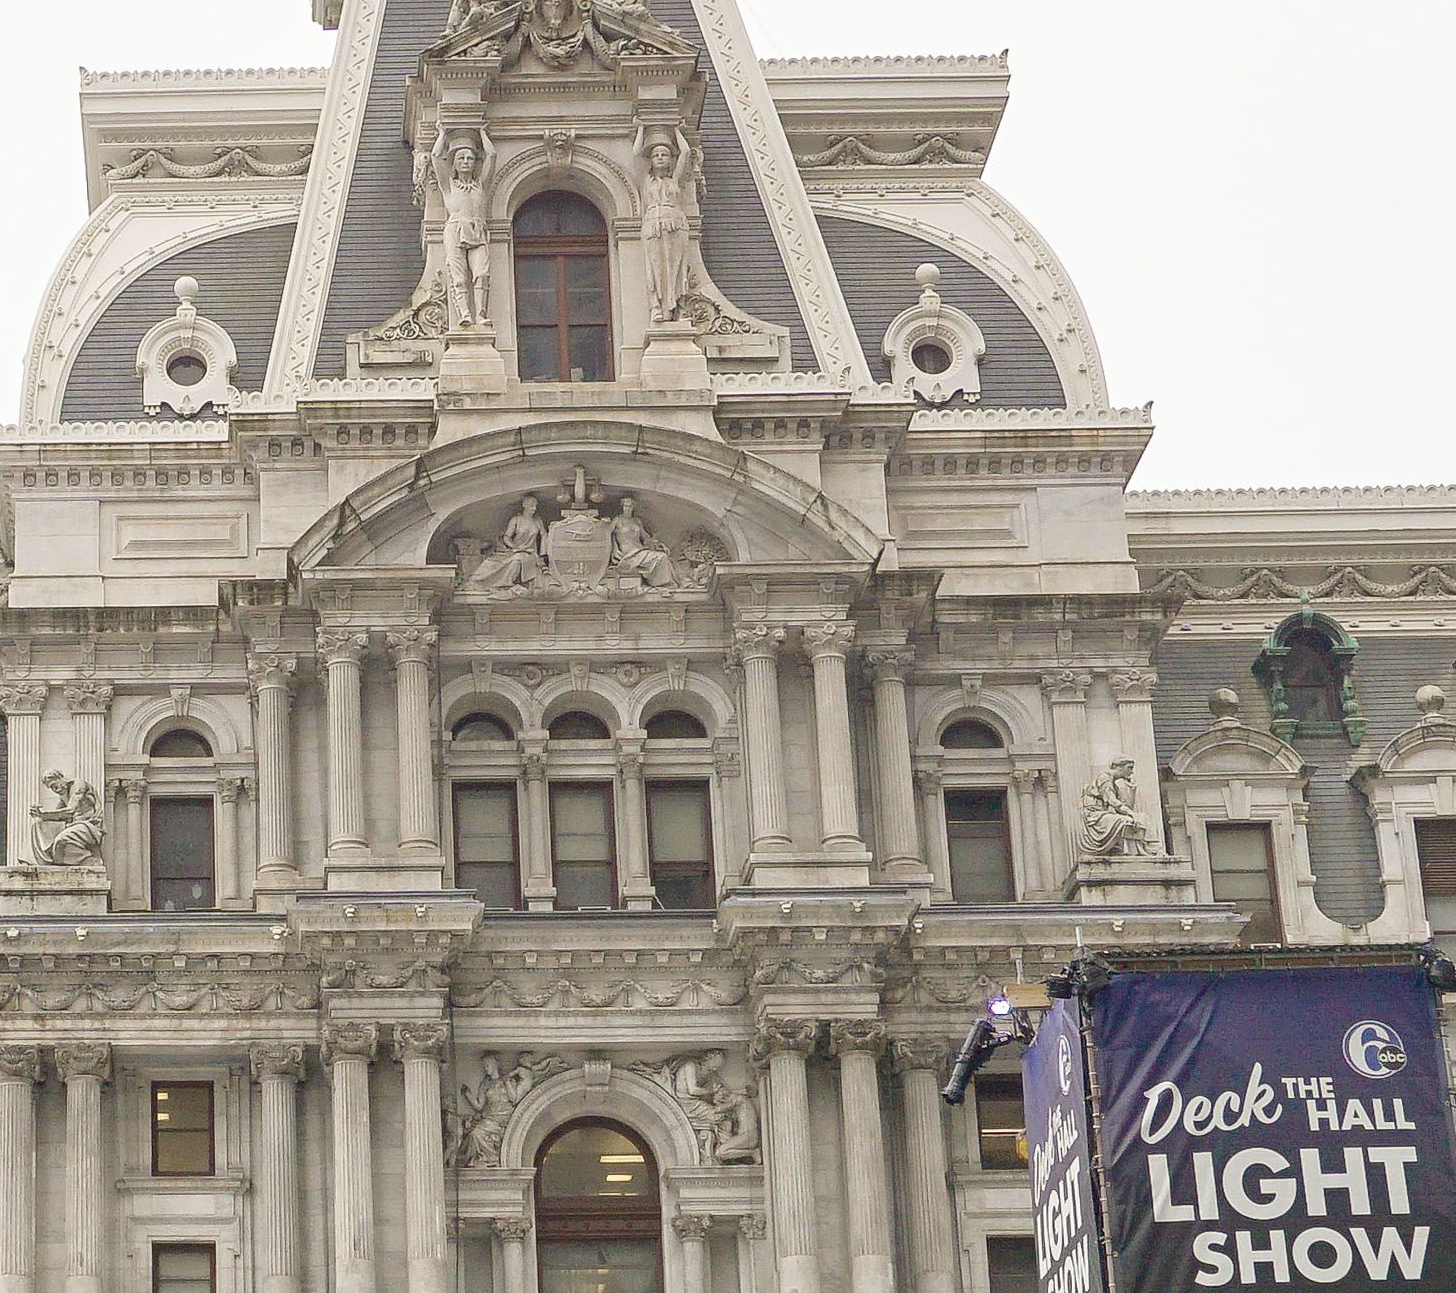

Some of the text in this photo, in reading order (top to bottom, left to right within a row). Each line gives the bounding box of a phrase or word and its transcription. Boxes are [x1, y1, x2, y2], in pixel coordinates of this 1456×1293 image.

[1378, 1052, 1405, 1063] abc
[1141, 1062, 1335, 1144] Deck THE
[1307, 1097, 1415, 1131] HALL
[1057, 1110, 1078, 1162] HALL
[1148, 1146, 1417, 1223] LIGHT
[1035, 1156, 1082, 1280] LIGHT
[1193, 1226, 1430, 1287] SHOW
